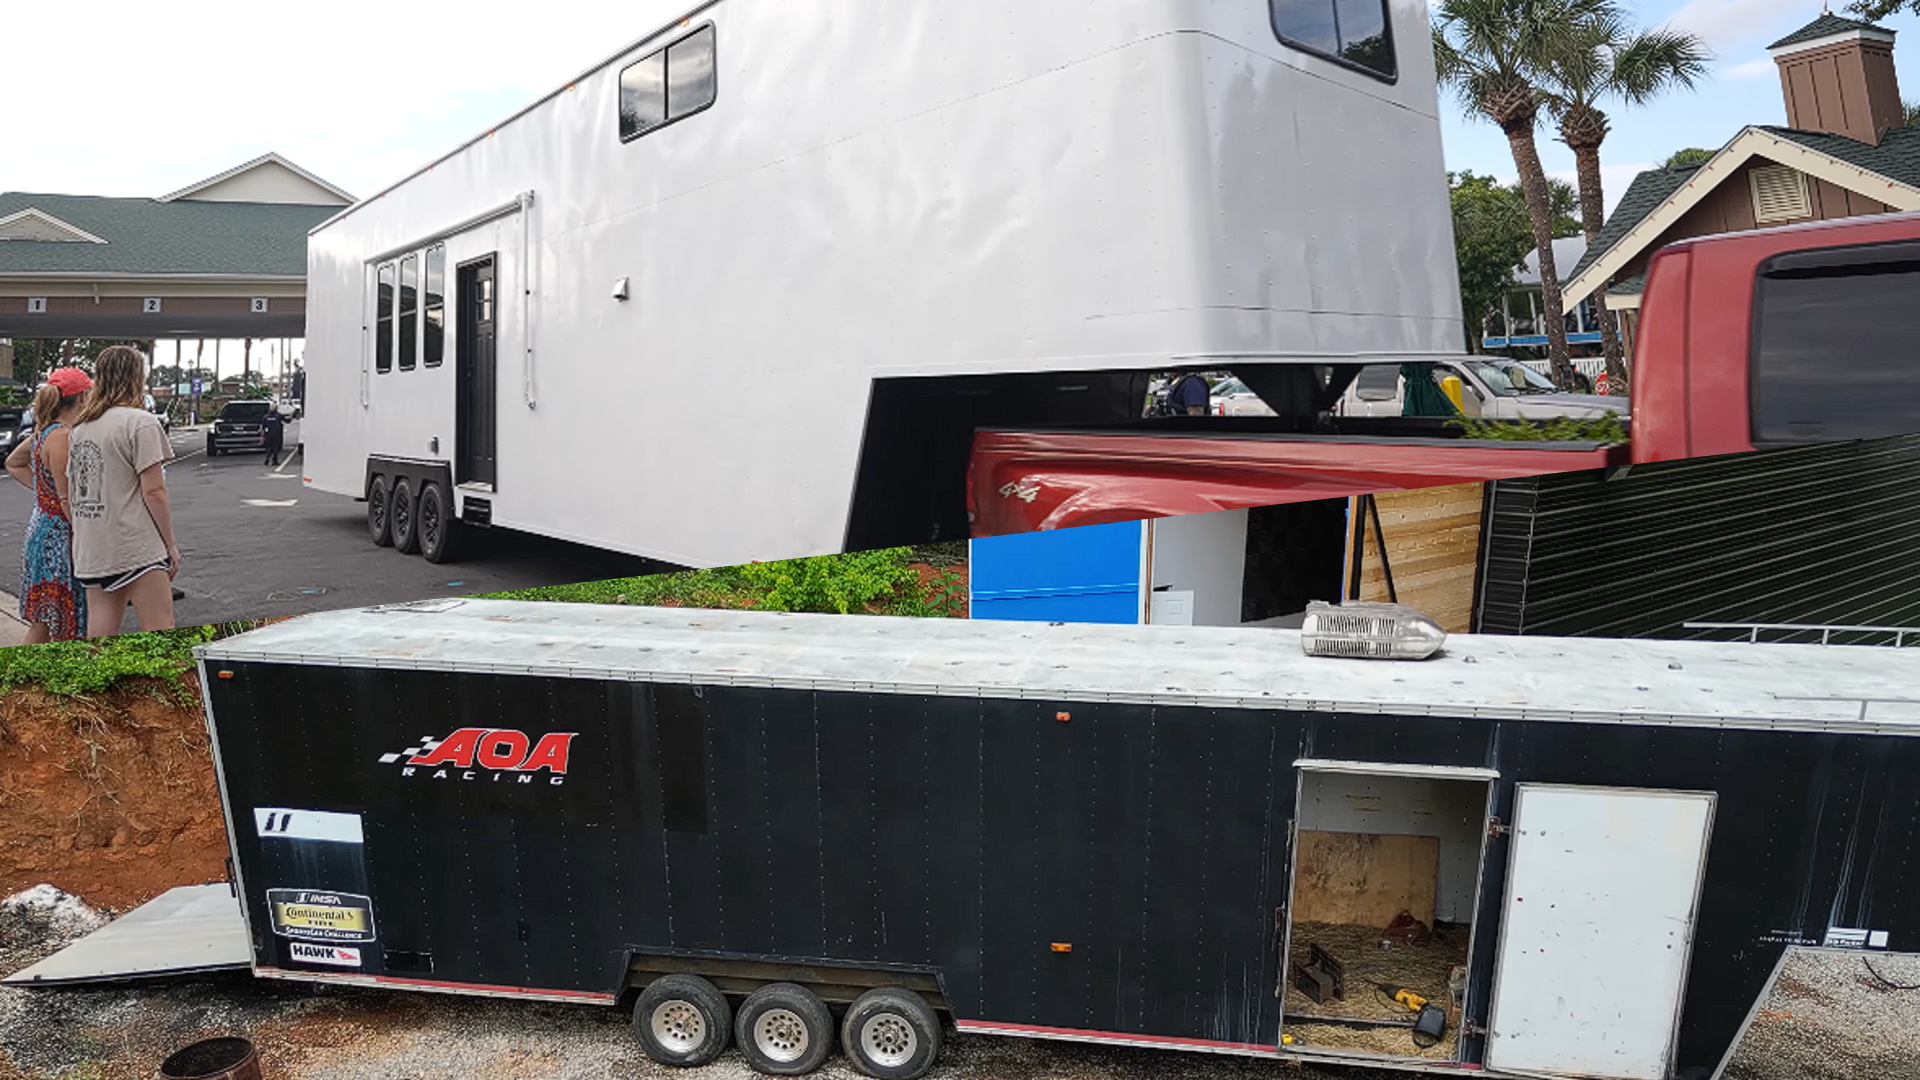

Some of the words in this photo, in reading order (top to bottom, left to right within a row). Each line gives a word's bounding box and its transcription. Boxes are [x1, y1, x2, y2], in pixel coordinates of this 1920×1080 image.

[34, 300, 41, 310] 1
[148, 300, 156, 310] 2
[255, 300, 263, 310] 3
[406, 727, 579, 774] AOA
[402, 767, 564, 785] RACING
[293, 945, 335, 958] HAWK
